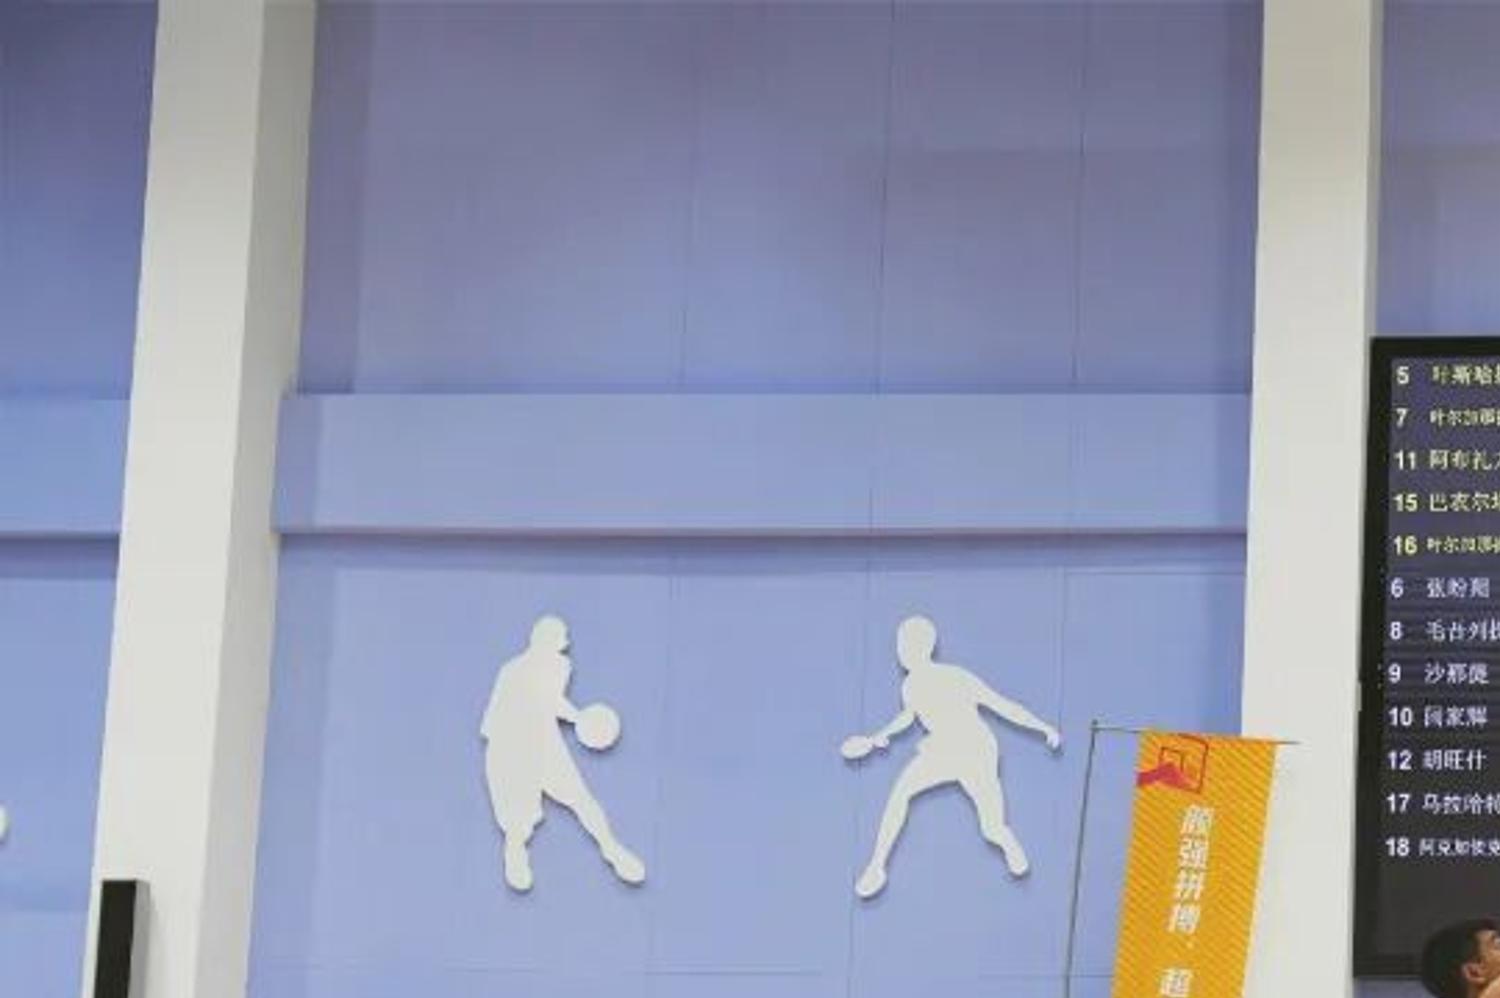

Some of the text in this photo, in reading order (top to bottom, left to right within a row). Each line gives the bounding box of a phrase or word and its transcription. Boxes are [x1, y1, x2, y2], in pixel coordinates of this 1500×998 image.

[1397, 366, 1409, 384] 5
[1397, 408, 1408, 426] 7
[1394, 450, 1415, 469] 11
[1394, 494, 1417, 511] 15
[1394, 536, 1417, 554] 16
[1391, 578, 1403, 598] 6
[1390, 622, 1402, 640] 8
[1389, 664, 1401, 683] 9
[1389, 707, 1413, 726] 10
[1389, 750, 1411, 770] 12
[1387, 793, 1410, 812] 17
[1386, 838, 1409, 856] 18
